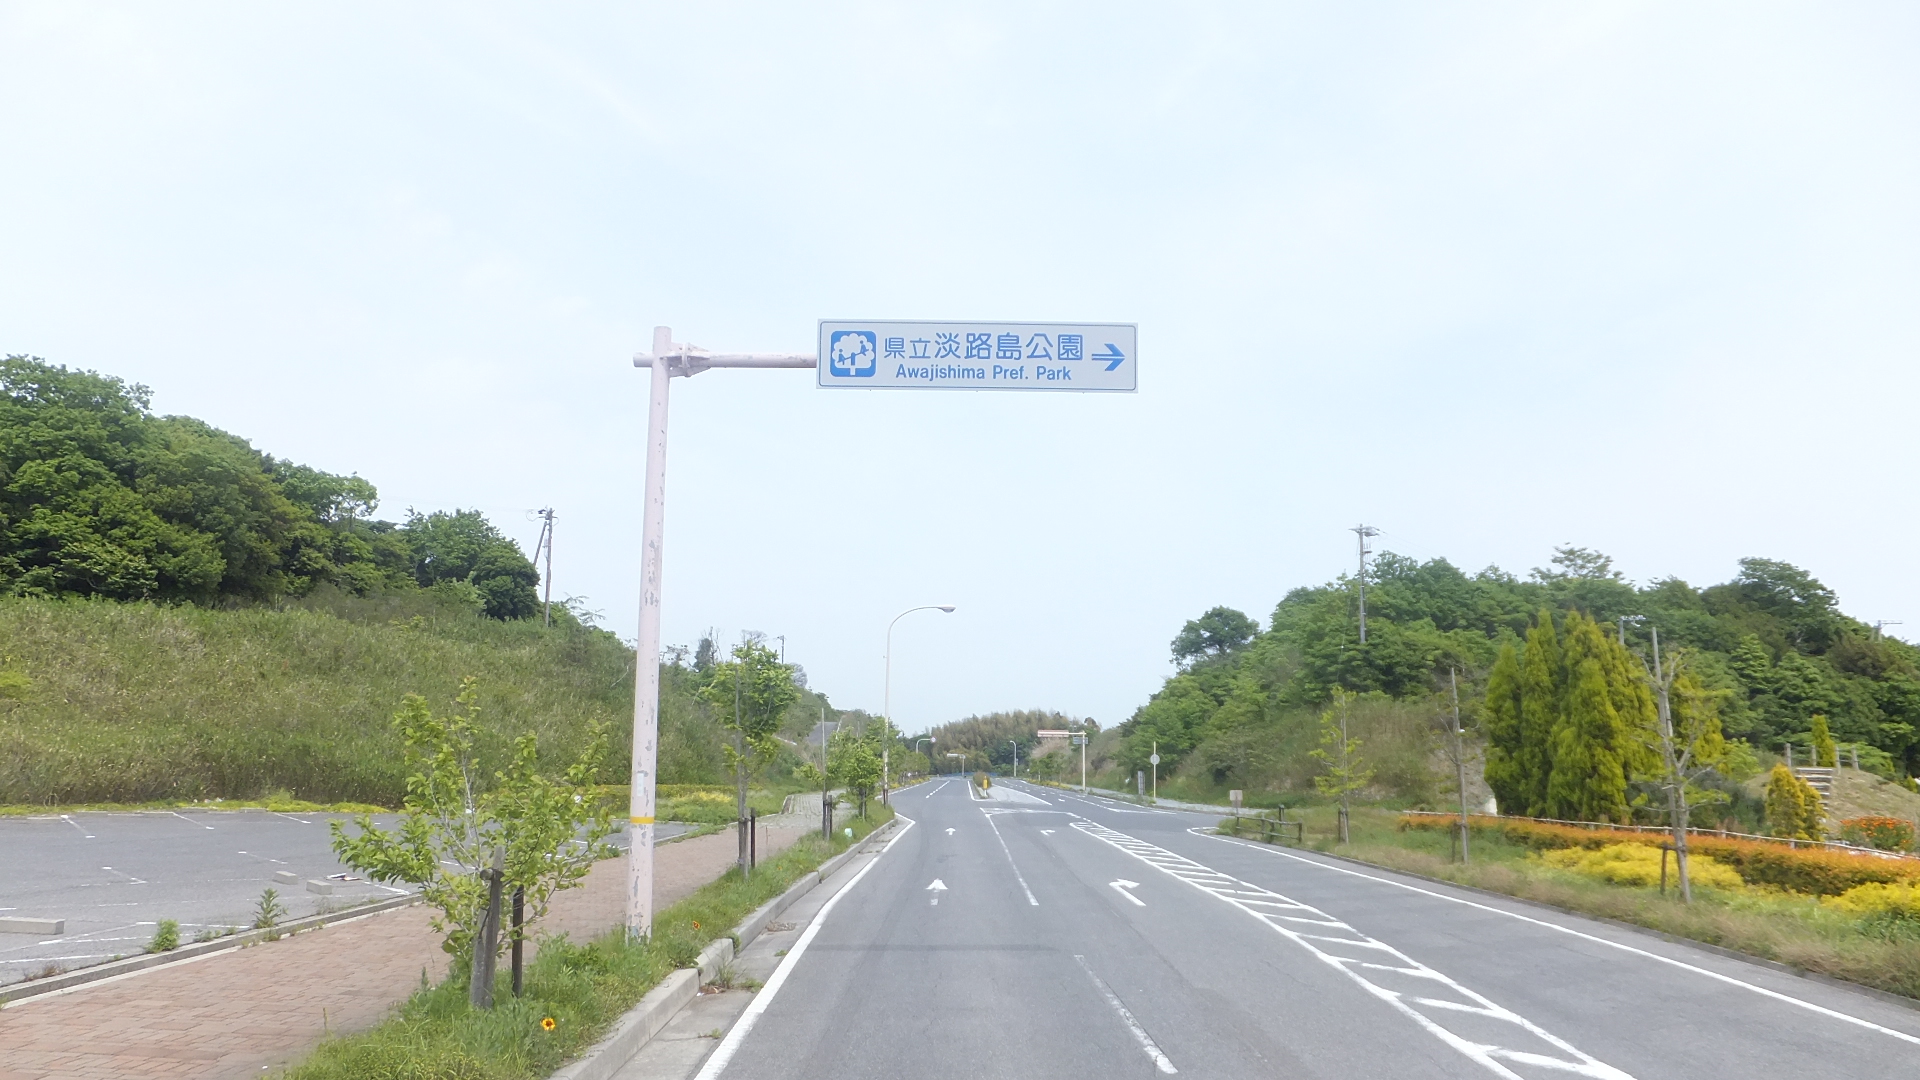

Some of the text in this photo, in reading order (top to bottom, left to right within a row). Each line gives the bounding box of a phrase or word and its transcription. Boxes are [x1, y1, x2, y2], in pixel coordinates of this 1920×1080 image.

[884, 332, 1083, 361] 県立淡路島公園
[895, 363, 1072, 381] Awajishima Pref. Park
